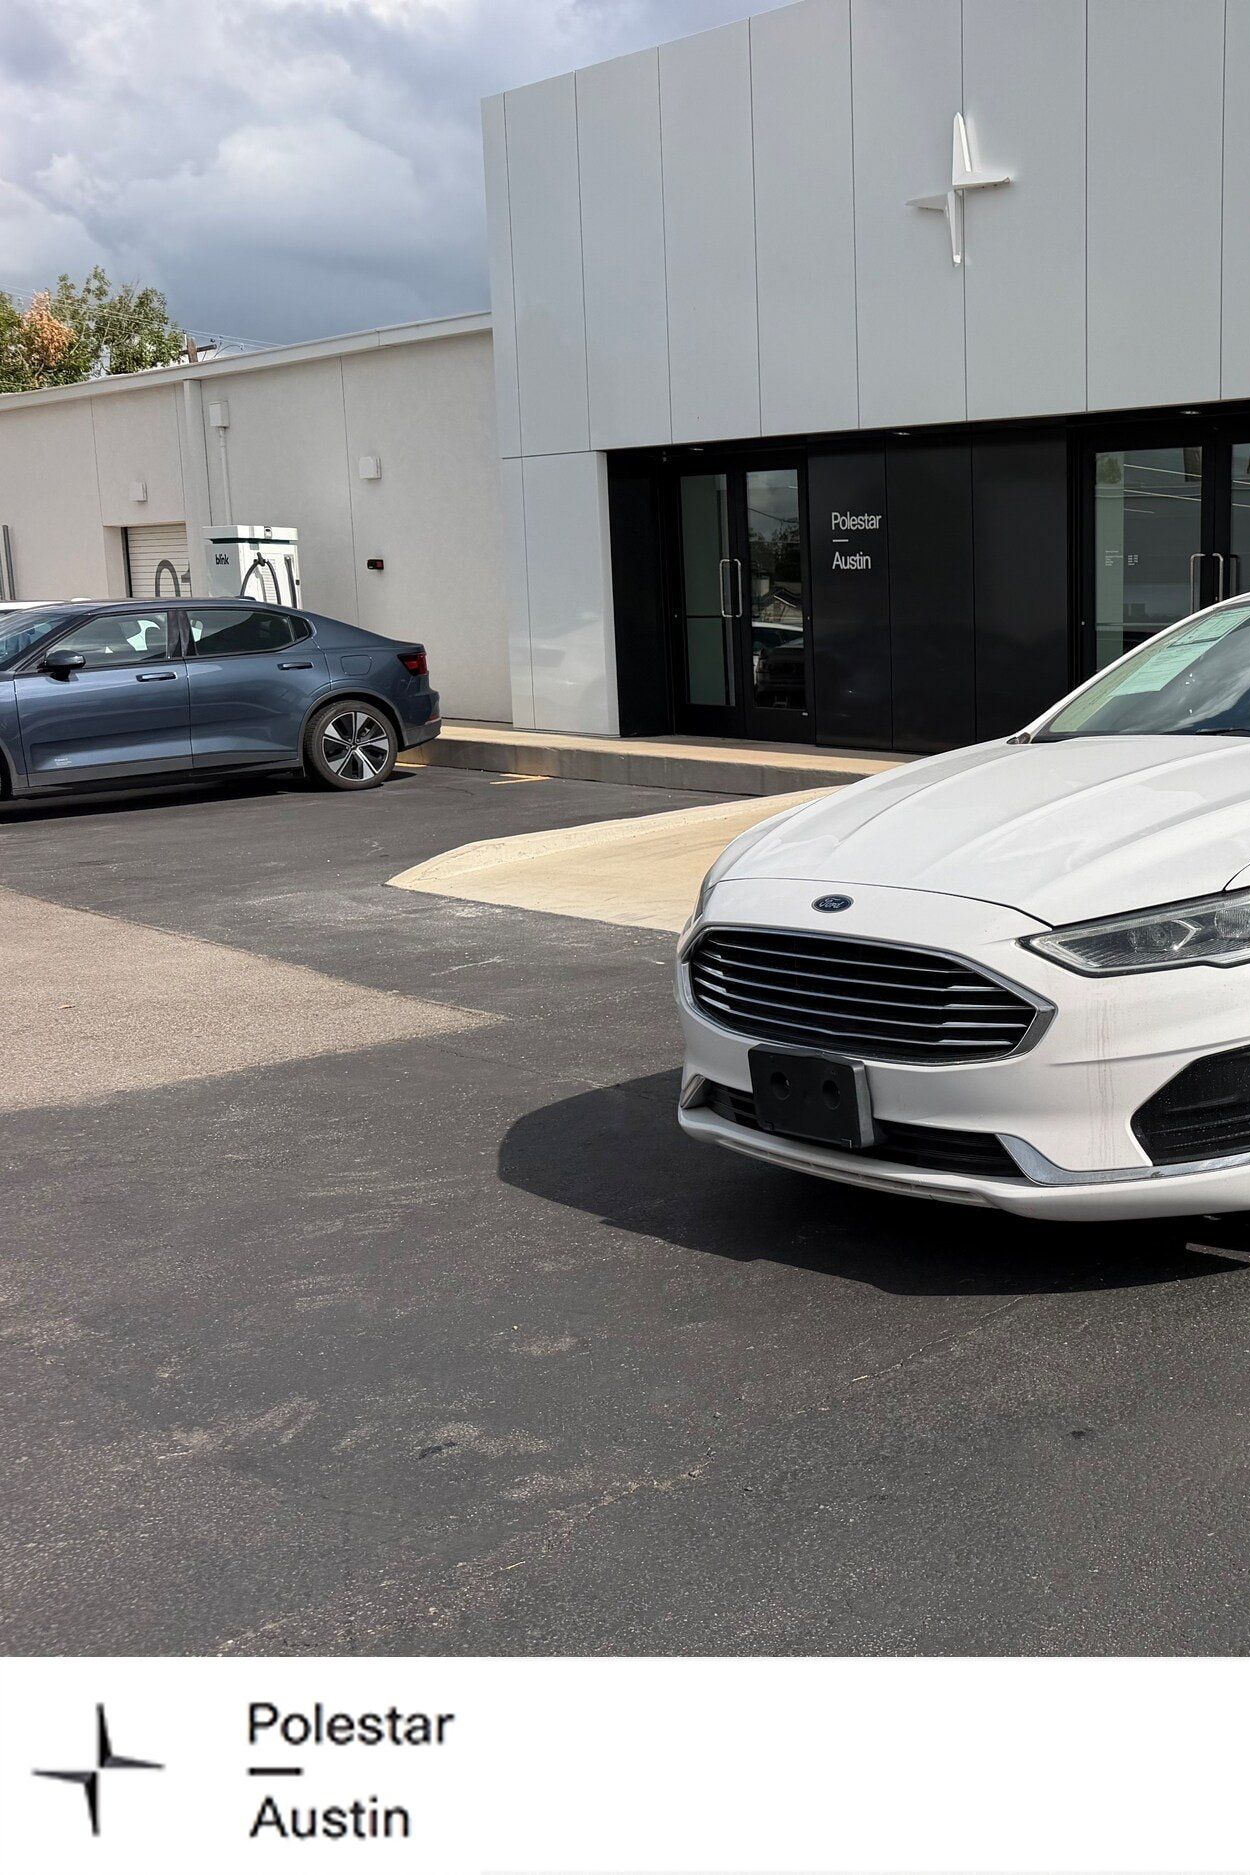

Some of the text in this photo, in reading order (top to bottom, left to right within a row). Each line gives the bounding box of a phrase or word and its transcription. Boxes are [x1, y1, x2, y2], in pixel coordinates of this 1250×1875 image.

[831, 511, 882, 530] Polestar
[215, 553, 230, 565] blink
[832, 552, 871, 570] Austin
[816, 896, 848, 910] Ford
